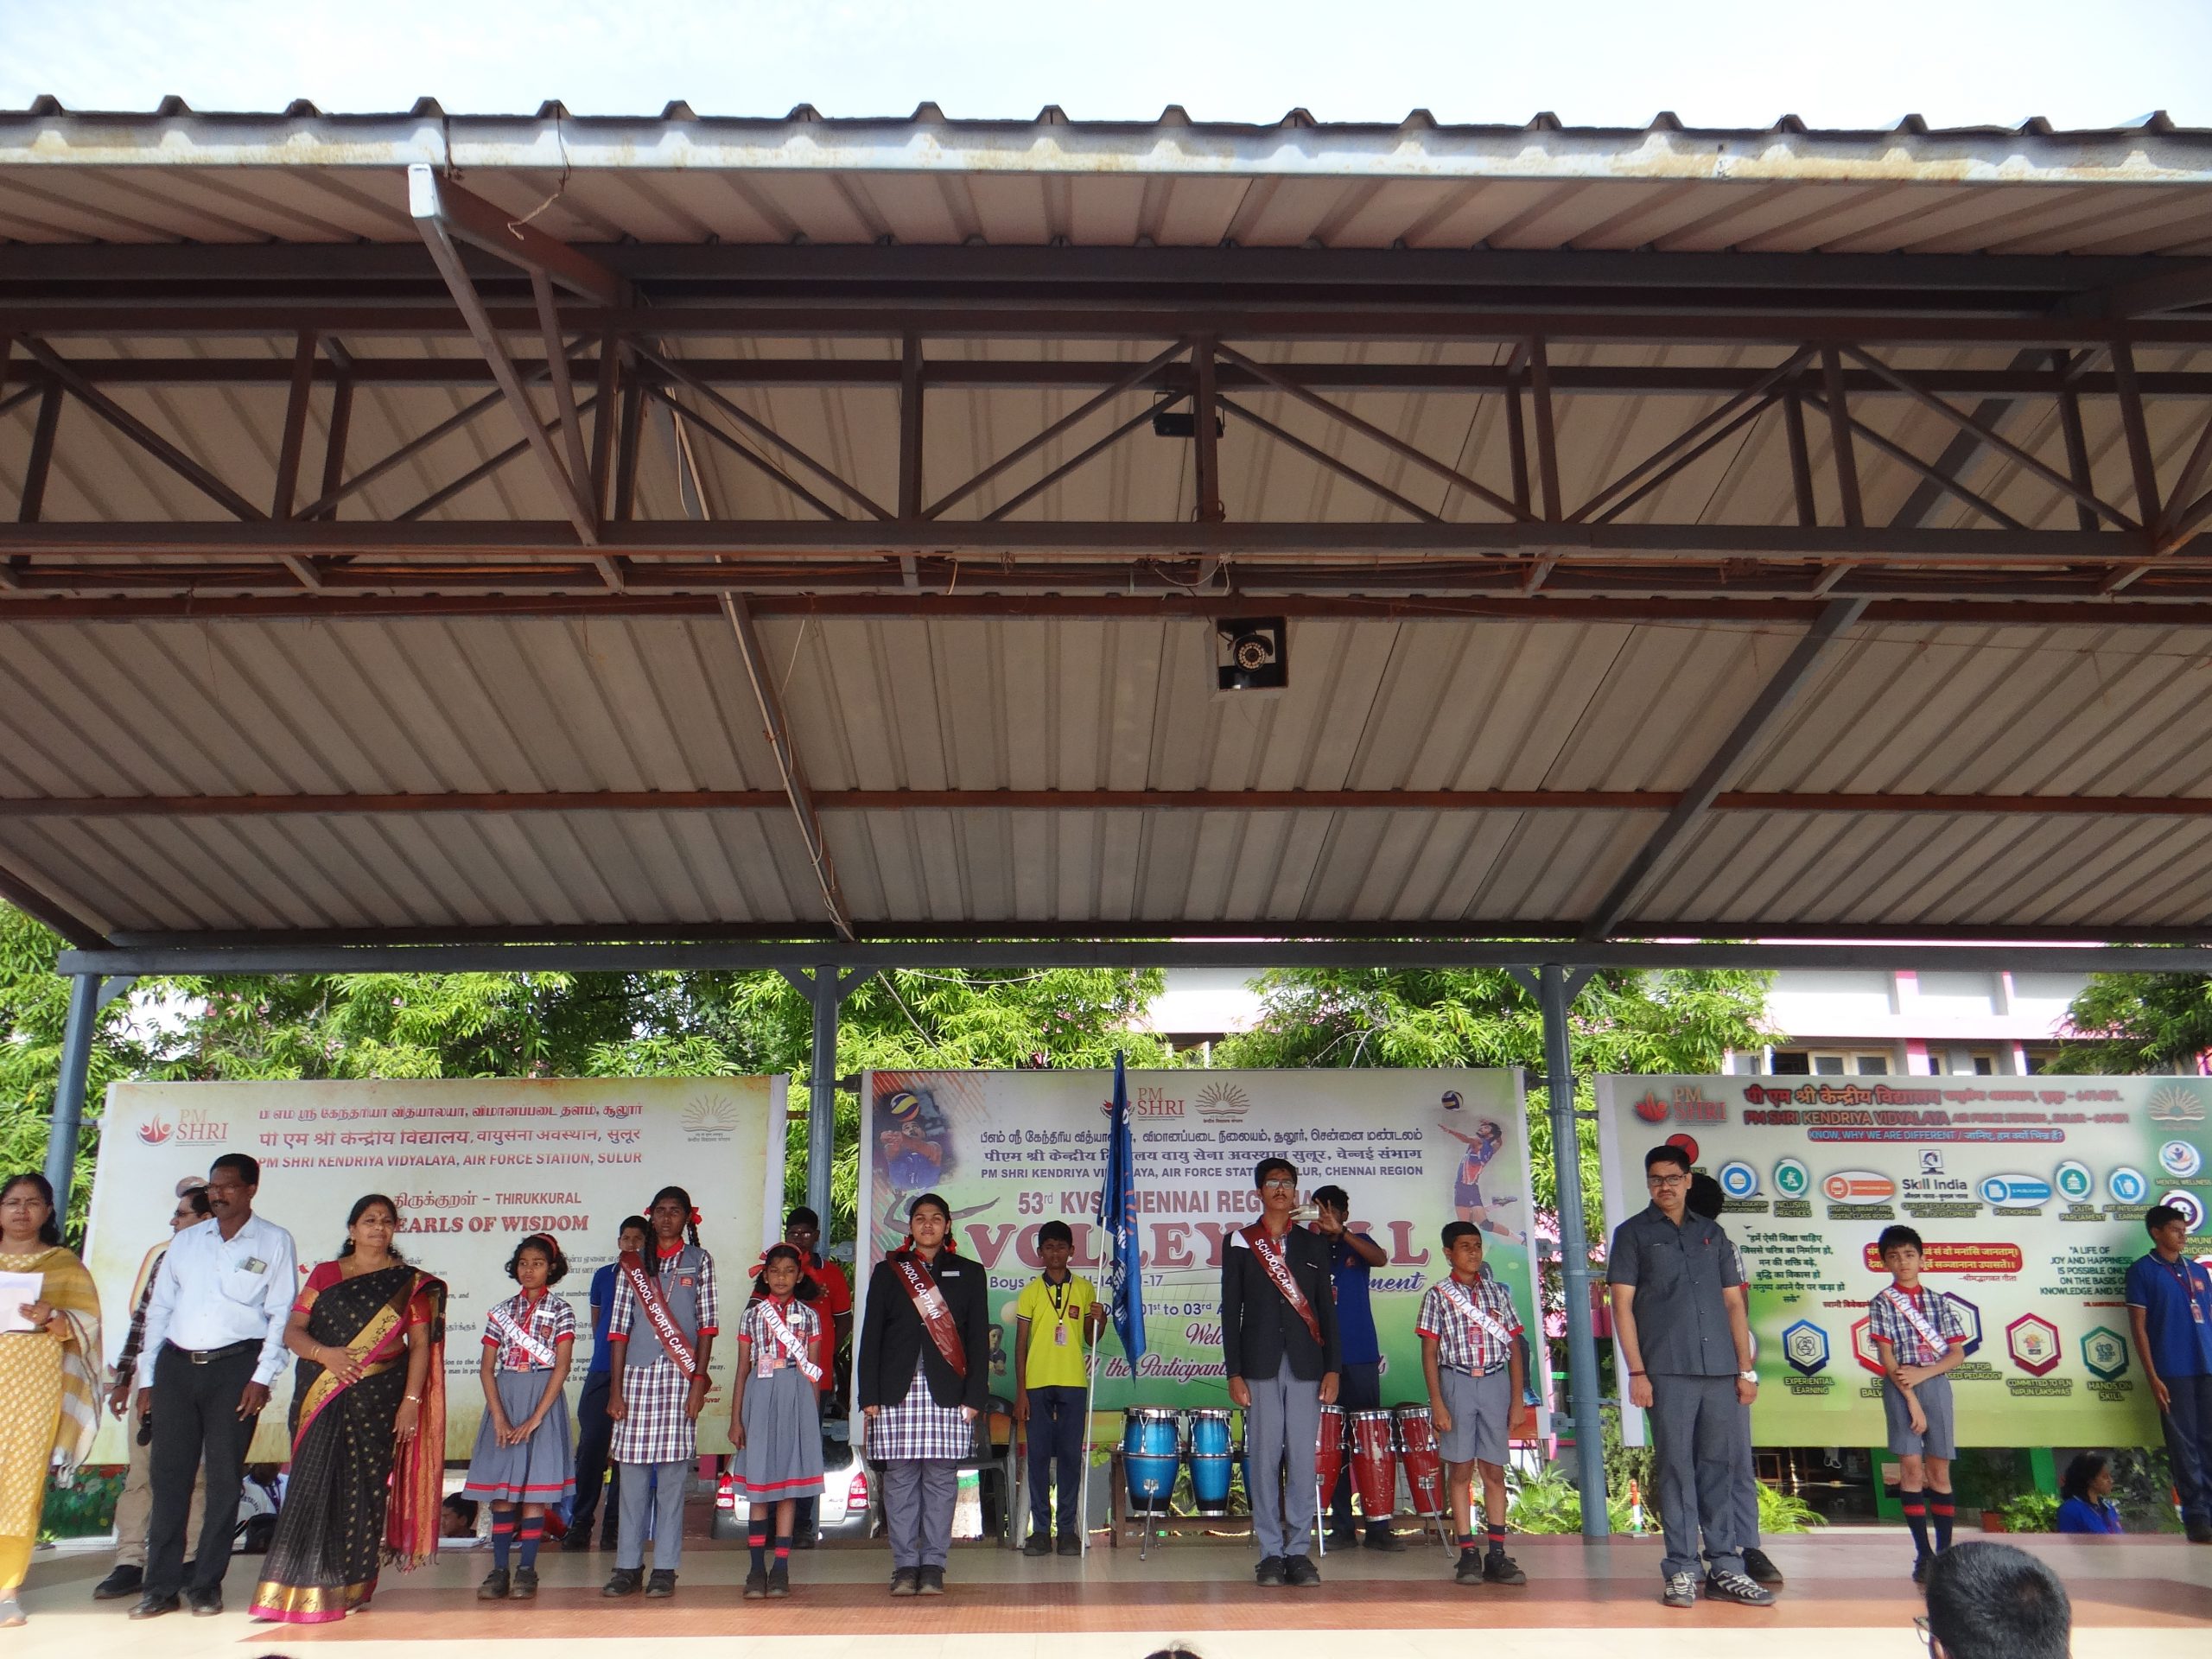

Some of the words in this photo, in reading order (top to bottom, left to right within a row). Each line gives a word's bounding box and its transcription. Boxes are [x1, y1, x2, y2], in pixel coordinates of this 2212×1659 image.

[1138, 1087, 1164, 1101] PM
[1674, 1087, 1702, 1103] PM
[1795, 1084, 1815, 1104] श्री
[1818, 1084, 1872, 1105] केन्द्रीय
[180, 1109, 208, 1122] PM
[1137, 1100, 1185, 1116] SHRI
[1674, 1102, 1726, 1120] SHRI
[1744, 1110, 1765, 1125] PM
[1767, 1110, 1800, 1125] SHRI
[1802, 1110, 1873, 1125] KENDRIYA
[1873, 1110, 1951, 1126] VIDYALAYA
[175, 1123, 228, 1141] SHRI
[1142, 1129, 1216, 1142] விமானப்படை
[1311, 1128, 1363, 1141] சென்னை
[1367, 1128, 1423, 1141] மண்டலம்
[1809, 1130, 1840, 1141] KNOW,
[1842, 1130, 1865, 1140] WHY
[1866, 1130, 1881, 1140] WE
[1883, 1130, 1902, 1140] ARE
[1904, 1130, 1955, 1140] DIFFERENT
[283, 1132, 309, 1150] एम
[259, 1157, 278, 1167] PM
[283, 1156, 314, 1167] SHRI
[318, 1155, 385, 1167] KENDRIYA
[388, 1154, 460, 1167] VIDYALAYA,
[463, 1153, 486, 1166] AIR
[490, 1153, 532, 1165] FORCE
[536, 1152, 594, 1166] STATION,
[598, 1152, 642, 1163] SULUR
[984, 1148, 1023, 1161] पीएम
[1027, 1148, 1046, 1161] श्री
[1049, 1148, 1096, 1162] केन्द्रीय
[1193, 1148, 1224, 1160] सेना
[1377, 1146, 1422, 1160] संभाग
[981, 1169, 997, 1179] PM
[1001, 1169, 1027, 1179] SHRI
[1032, 1168, 1090, 1178] KENDRIYA
[1161, 1167, 1181, 1178] AIR
[1185, 1167, 1222, 1177] FORCE
[1325, 1166, 1376, 1176] CHENNAI
[1380, 1166, 1423, 1176] REGION
[1903, 1179, 1929, 1190] Skill
[1935, 1179, 1967, 1190] India
[495, 1192, 582, 1205] THIRUKKURAL
[1060, 1191, 1102, 1214] KVS
[395, 1217, 464, 1234] EARLS
[468, 1217, 497, 1232] OF
[501, 1215, 589, 1231] WISDOM
[1255, 1238, 1281, 1273] SCHOOL
[990, 1276, 1025, 1290] Boys
[914, 1282, 941, 1320] CAPTAIN
[1164, 1304, 1179, 1316] to
[1183, 1303, 1211, 1315] 03rd
[632, 1268, 655, 1304] SCHOOL
[649, 1302, 674, 1338] SPORTS
[669, 1337, 696, 1373] CAPTAIN
[779, 1331, 820, 1380] CAPTAIN
[1106, 1357, 1131, 1377] the
[1965, 1371, 2002, 1380] PEDAGOGY
[2006, 1379, 2047, 1388] COMMITTED
[1792, 1386, 1828, 1395] LEARNING
[2100, 1392, 2124, 1401] SKILL
